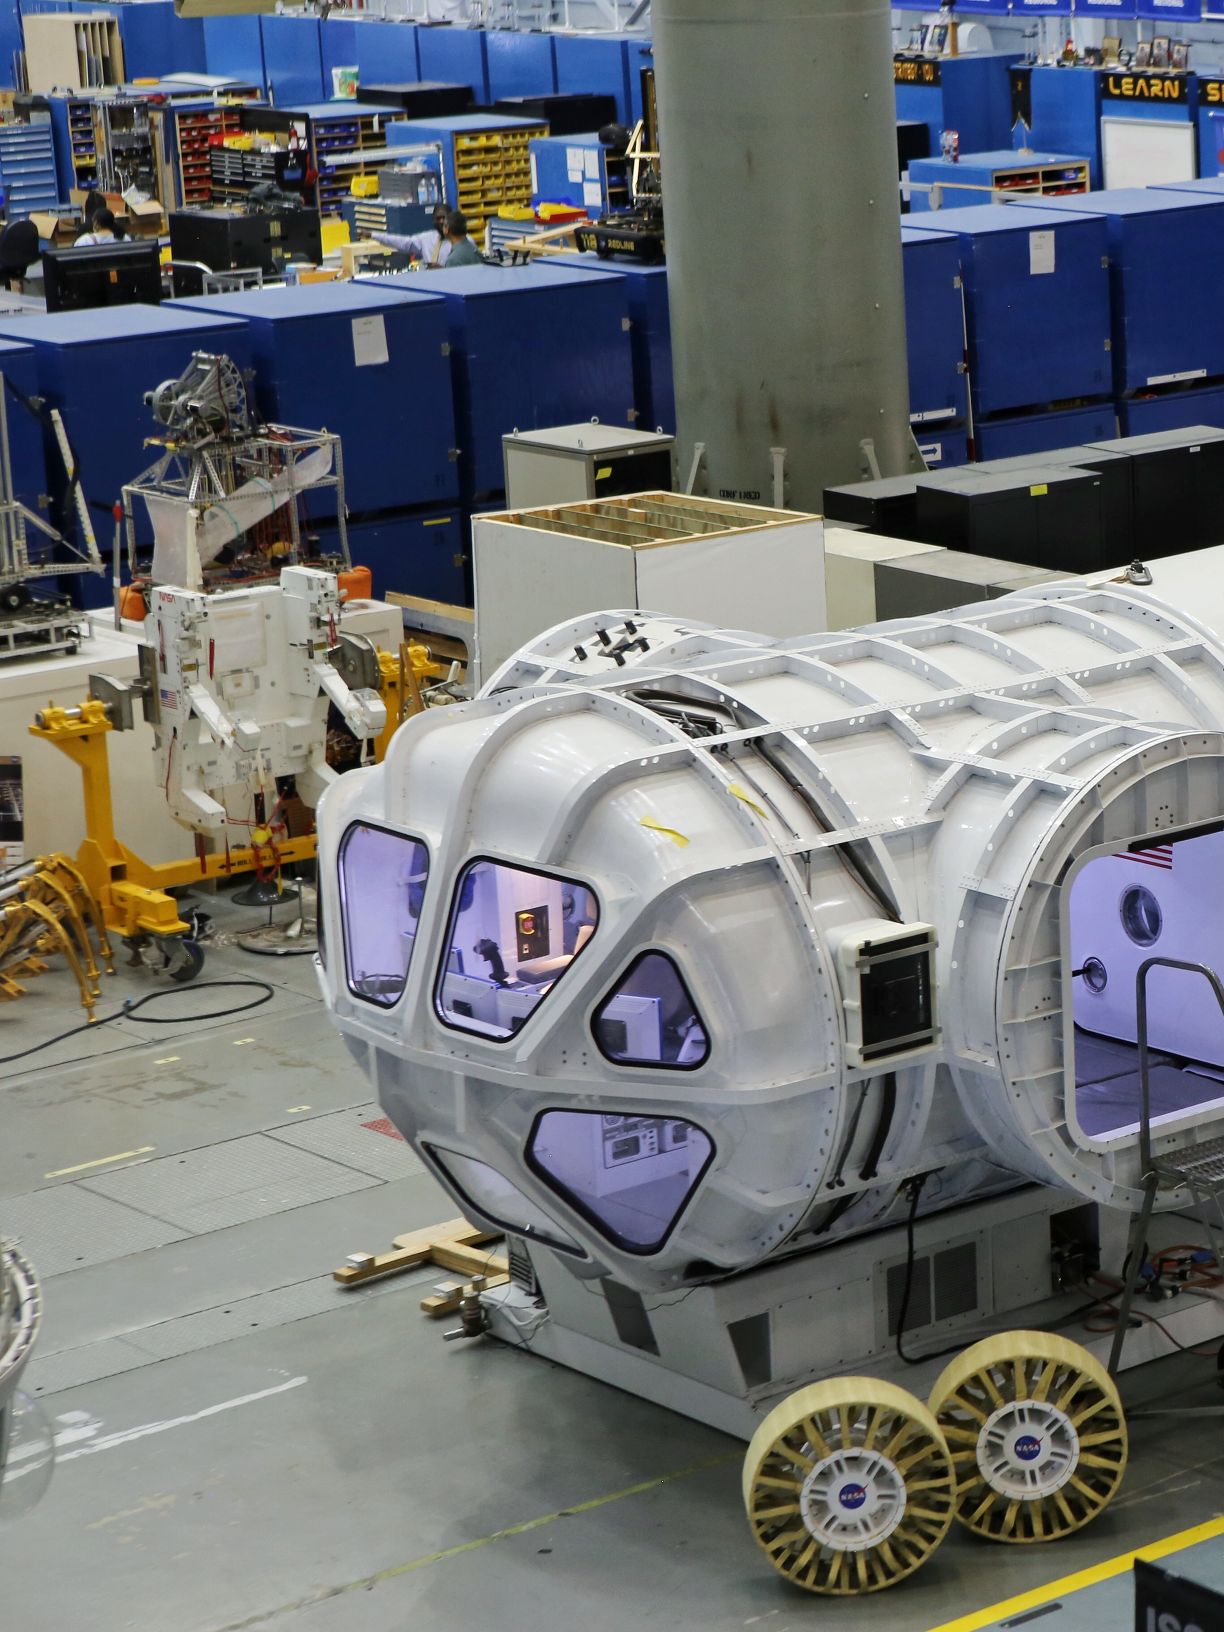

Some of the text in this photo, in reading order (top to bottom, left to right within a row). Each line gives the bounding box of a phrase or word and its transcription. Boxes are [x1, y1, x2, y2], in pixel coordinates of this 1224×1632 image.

[1108, 76, 1180, 98] LEARN
[159, 592, 176, 603] NASA
[1016, 1444, 1040, 1452] NASA
[840, 1492, 864, 1500] NASA
[1146, 1605, 1204, 1632] IS
